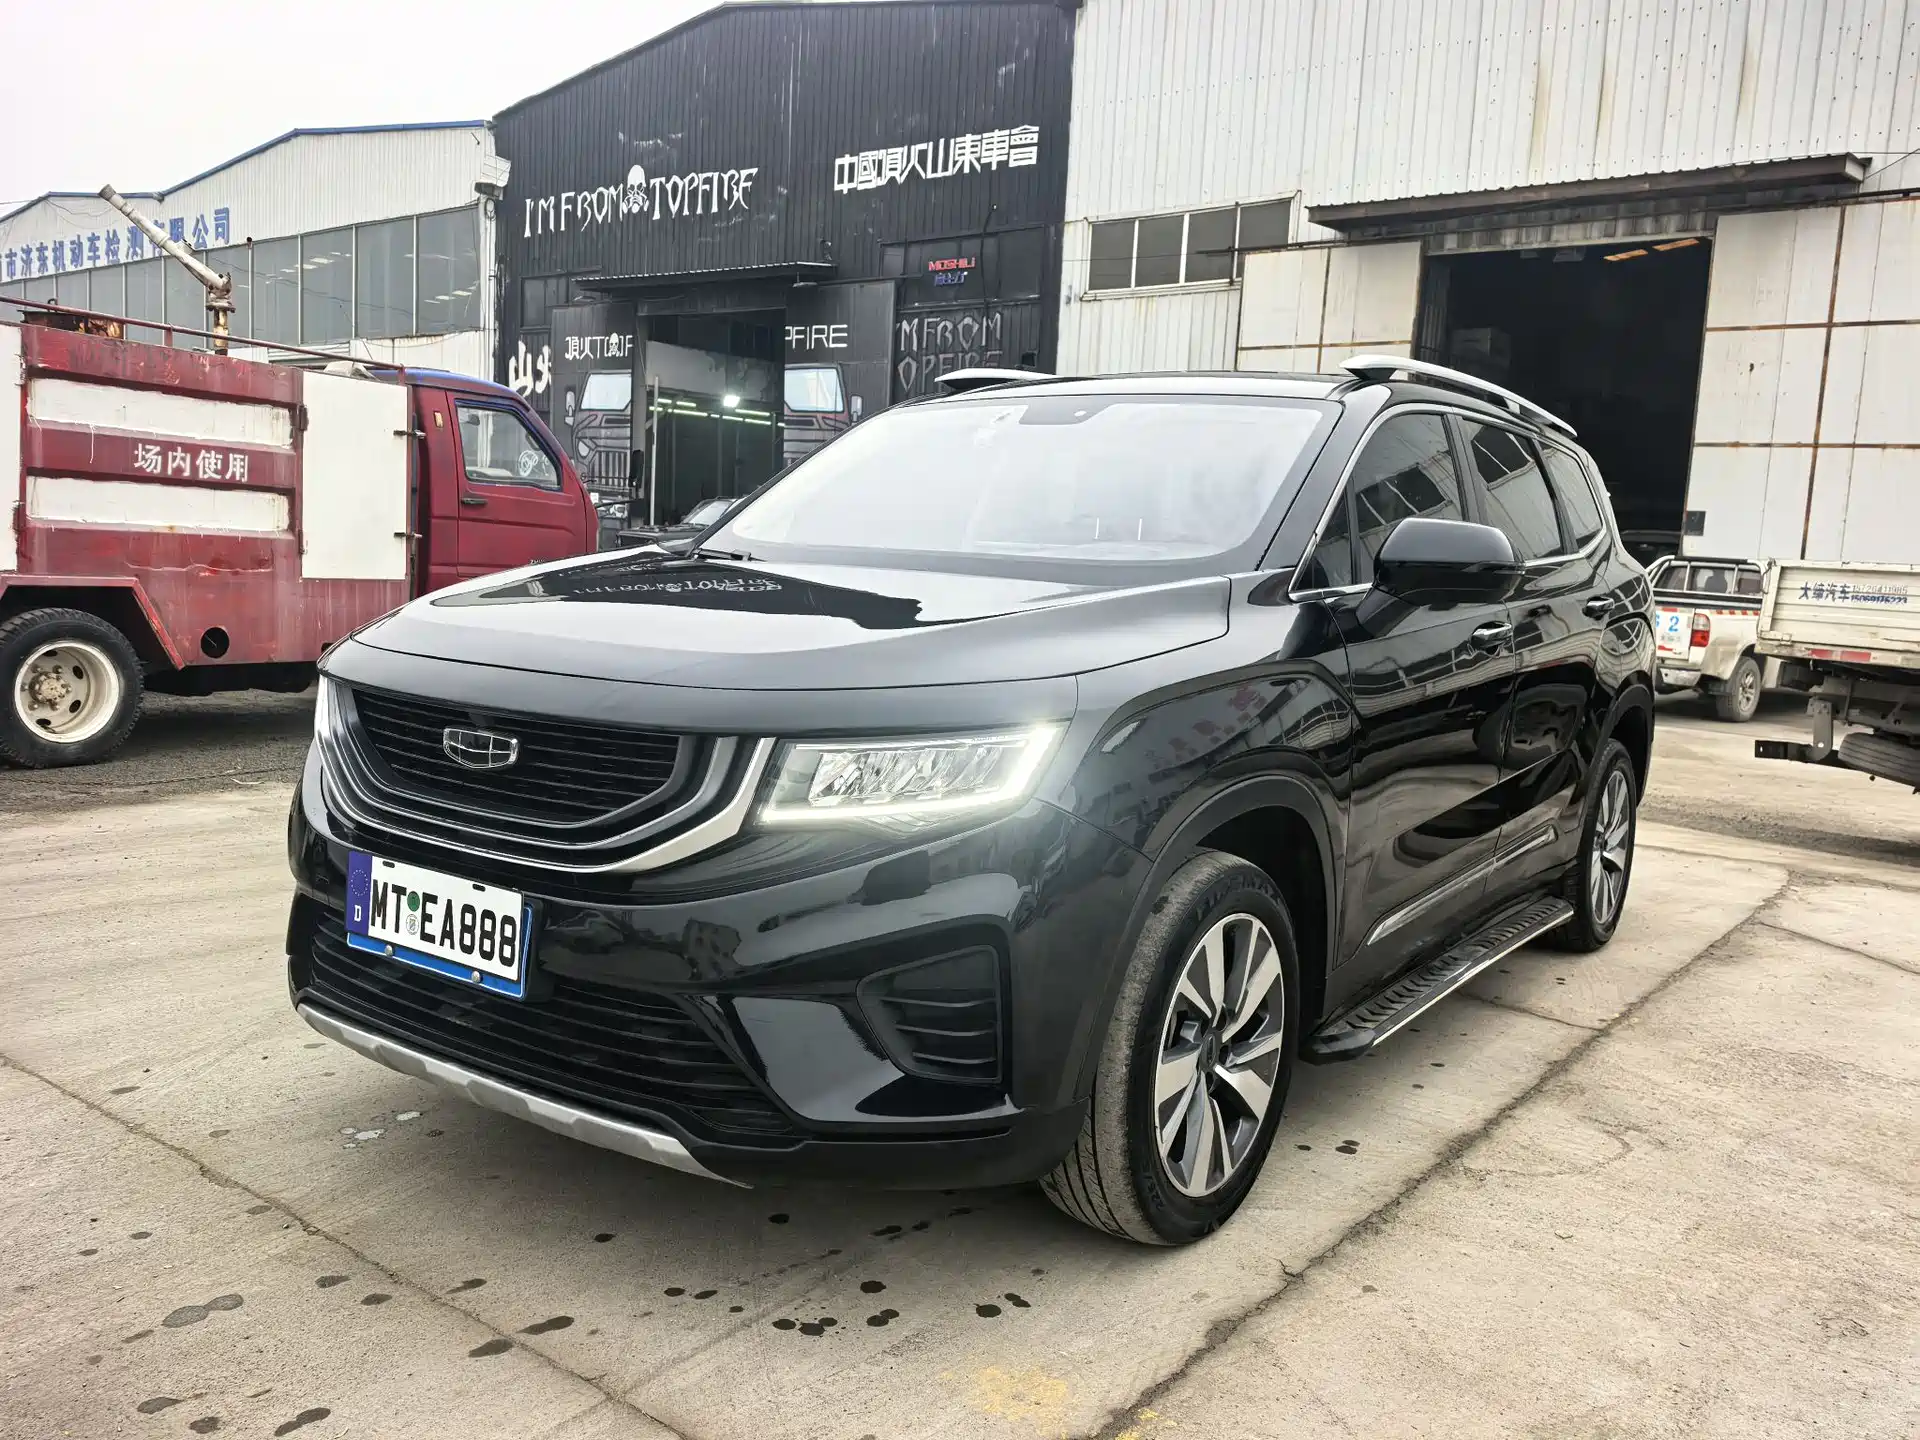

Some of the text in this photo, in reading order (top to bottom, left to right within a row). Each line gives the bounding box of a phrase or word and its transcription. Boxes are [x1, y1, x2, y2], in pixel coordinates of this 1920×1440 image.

[650, 167, 759, 221] TOPFIRE
[133, 443, 249, 483] 场内使用
[354, 904, 362, 922] D
[370, 879, 517, 968] MT EA888
